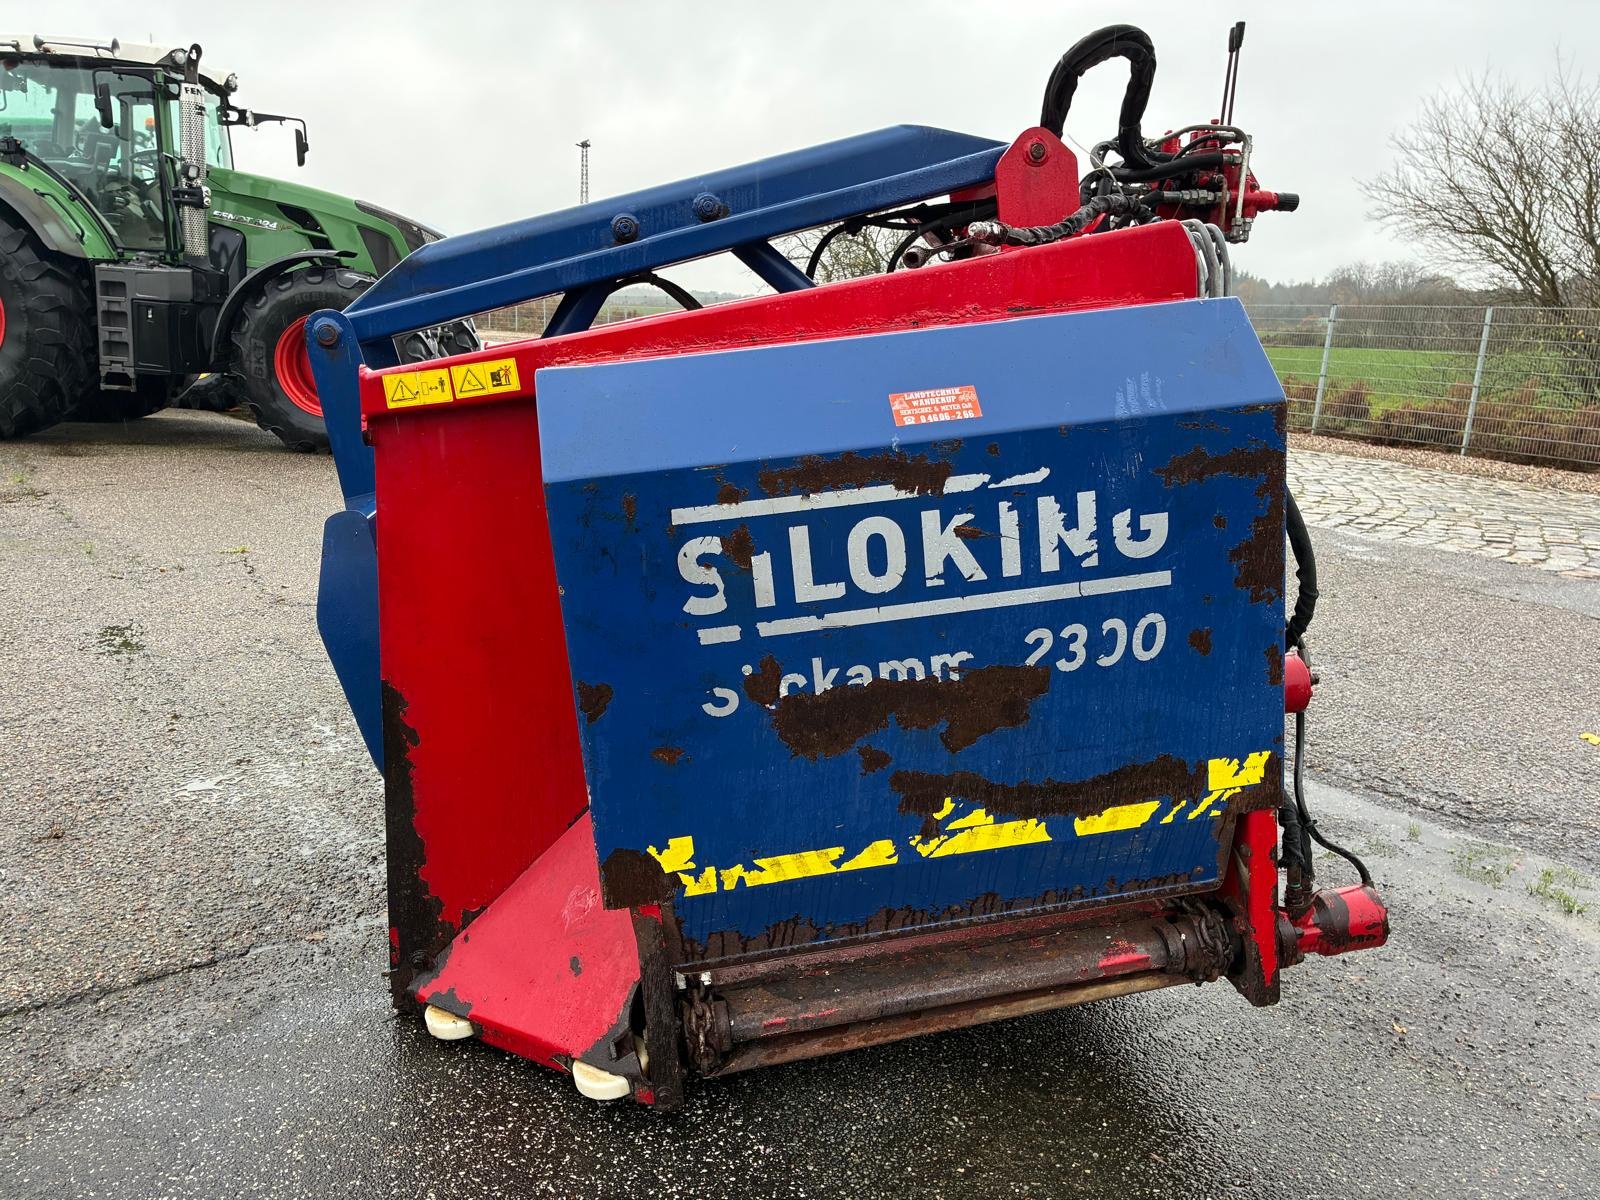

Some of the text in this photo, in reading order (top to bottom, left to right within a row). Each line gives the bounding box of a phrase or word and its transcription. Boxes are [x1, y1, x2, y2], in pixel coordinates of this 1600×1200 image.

[904, 388, 960, 400] LANDTECHNIK
[911, 396, 957, 407] WANDERUP
[677, 491, 1169, 616] SILOKING
[1023, 612, 1167, 673] 2300
